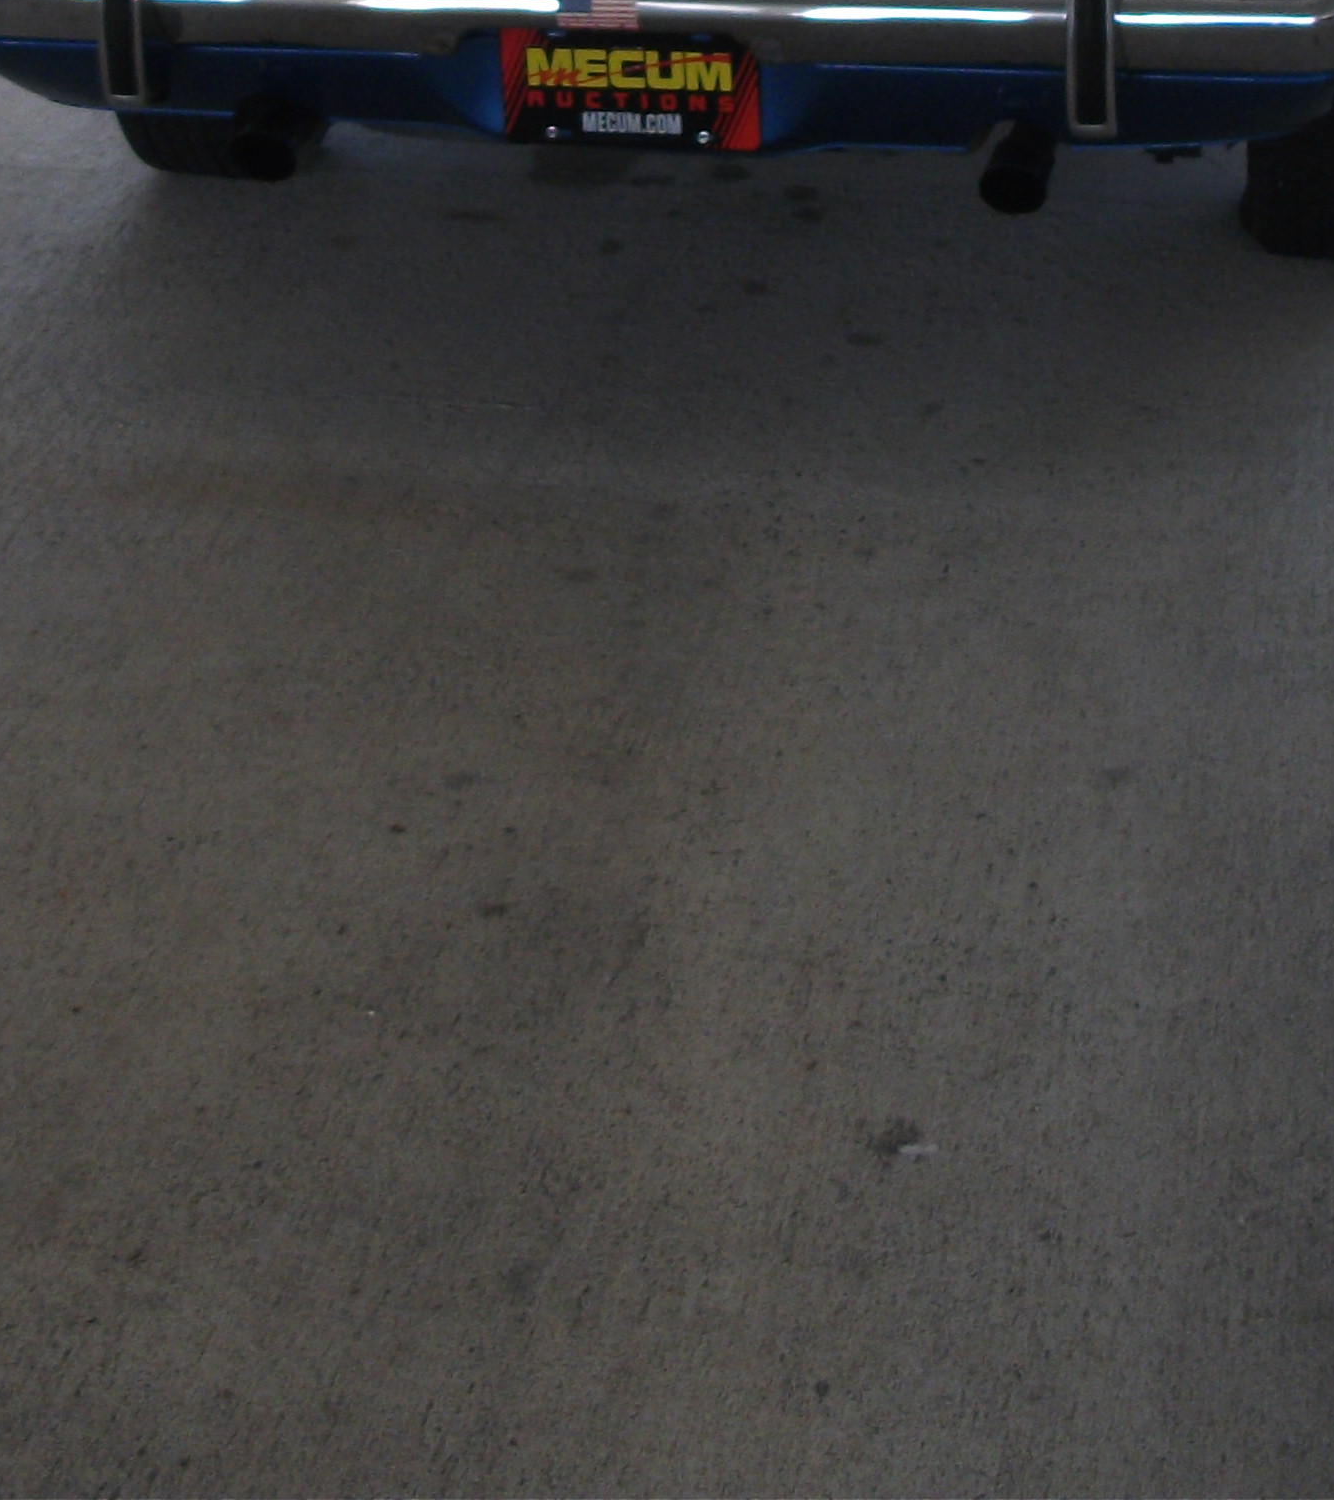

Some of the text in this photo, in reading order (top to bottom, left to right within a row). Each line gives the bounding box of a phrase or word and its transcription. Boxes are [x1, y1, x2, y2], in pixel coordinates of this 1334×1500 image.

[525, 47, 733, 91] MECUM
[526, 91, 735, 113] AUCTIONS
[582, 111, 682, 135] MECUM.COM
